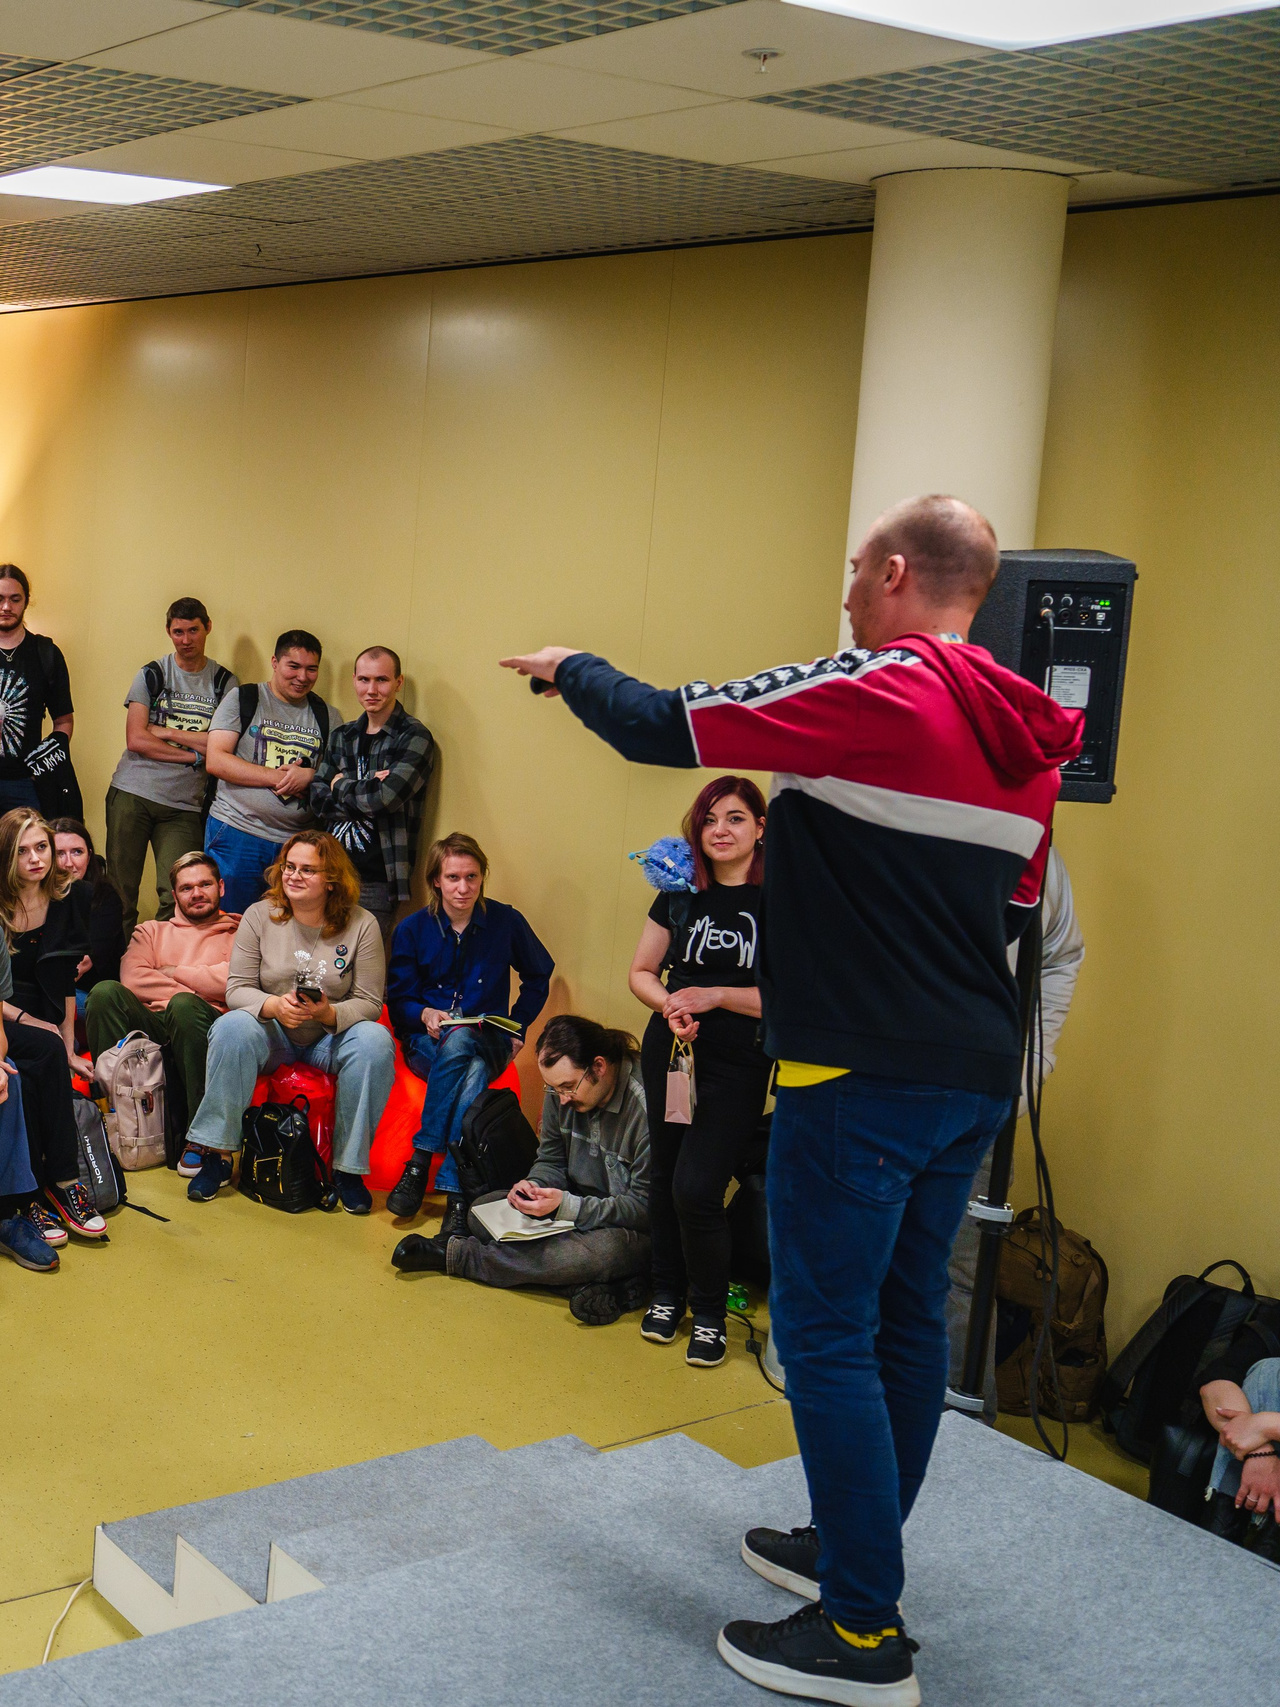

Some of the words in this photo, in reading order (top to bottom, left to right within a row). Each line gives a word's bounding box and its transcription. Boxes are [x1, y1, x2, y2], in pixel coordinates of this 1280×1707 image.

[263, 719, 320, 736] НЕЙТРАЛЬНО
[682, 911, 757, 969] MEOW
[83, 1135, 104, 1184] NORDSKI
